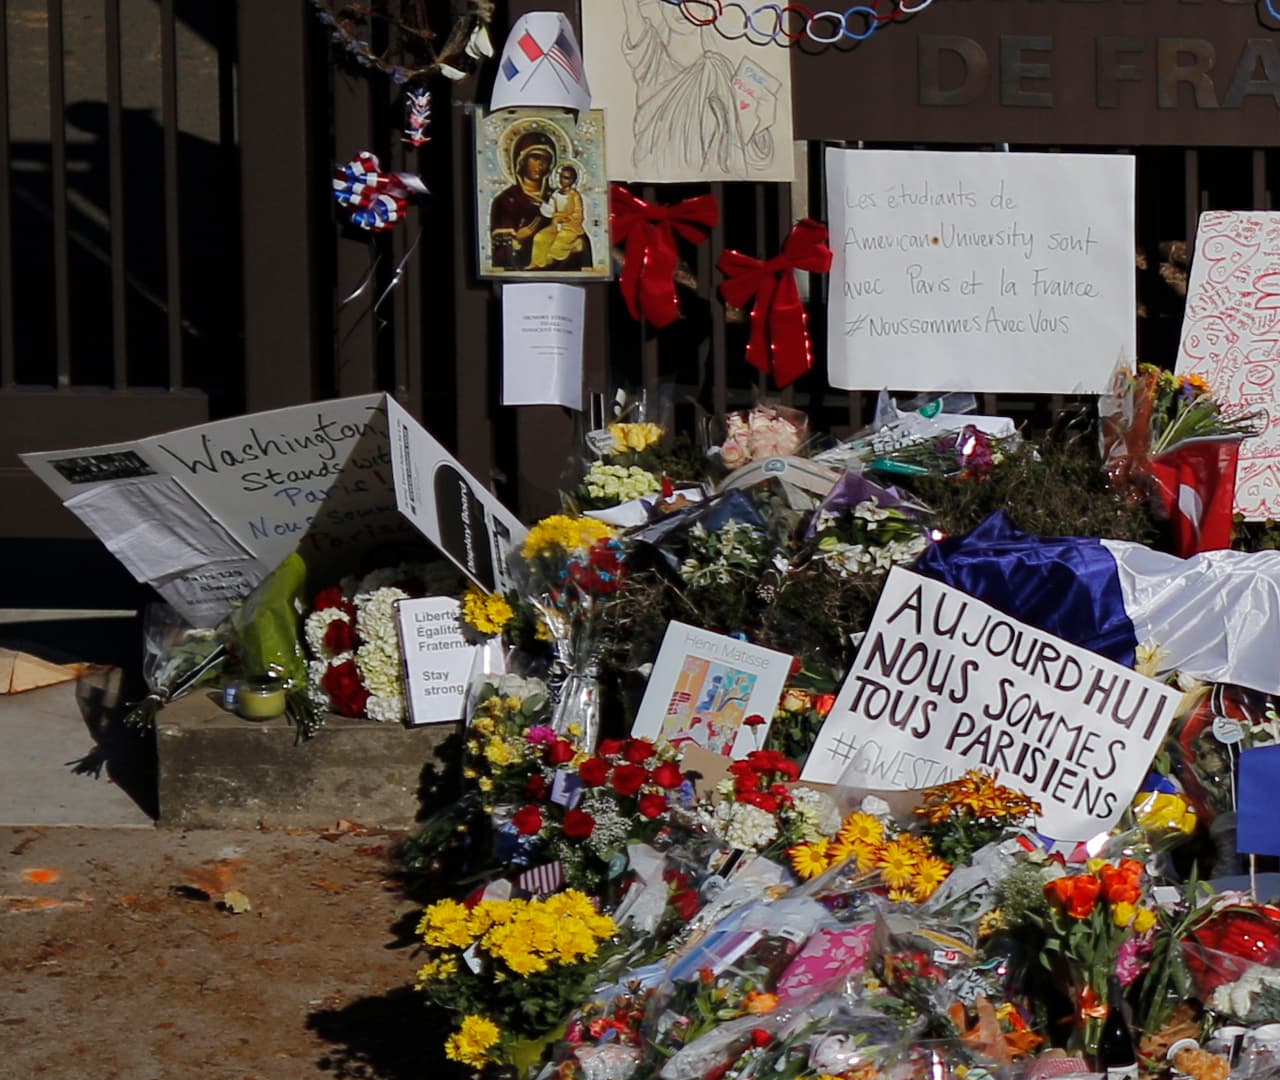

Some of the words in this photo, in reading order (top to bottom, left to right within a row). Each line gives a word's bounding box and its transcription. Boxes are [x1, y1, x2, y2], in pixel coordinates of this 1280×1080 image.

[917, 33, 1054, 110] DE
[845, 184, 877, 210] Les
[887, 178, 978, 209] étudiants
[990, 180, 1017, 210] de
[844, 226, 930, 251] American
[939, 222, 1034, 260] University
[1047, 227, 1099, 255] sont
[843, 276, 884, 300] avec
[906, 264, 951, 295] Paris
[960, 271, 984, 296] et
[1000, 267, 1017, 297] la
[684, 631, 718, 654] Henri
[722, 642, 770, 669] Matisse
[887, 584, 1168, 741] AUJOURD'HUI
[422, 671, 449, 681] Stay
[424, 685, 465, 696] strong
[864, 631, 980, 704] NOUS
[983, 677, 1126, 780] SOMMES
[848, 674, 938, 740] TOUS
[945, 711, 1119, 821] PARISIENS
